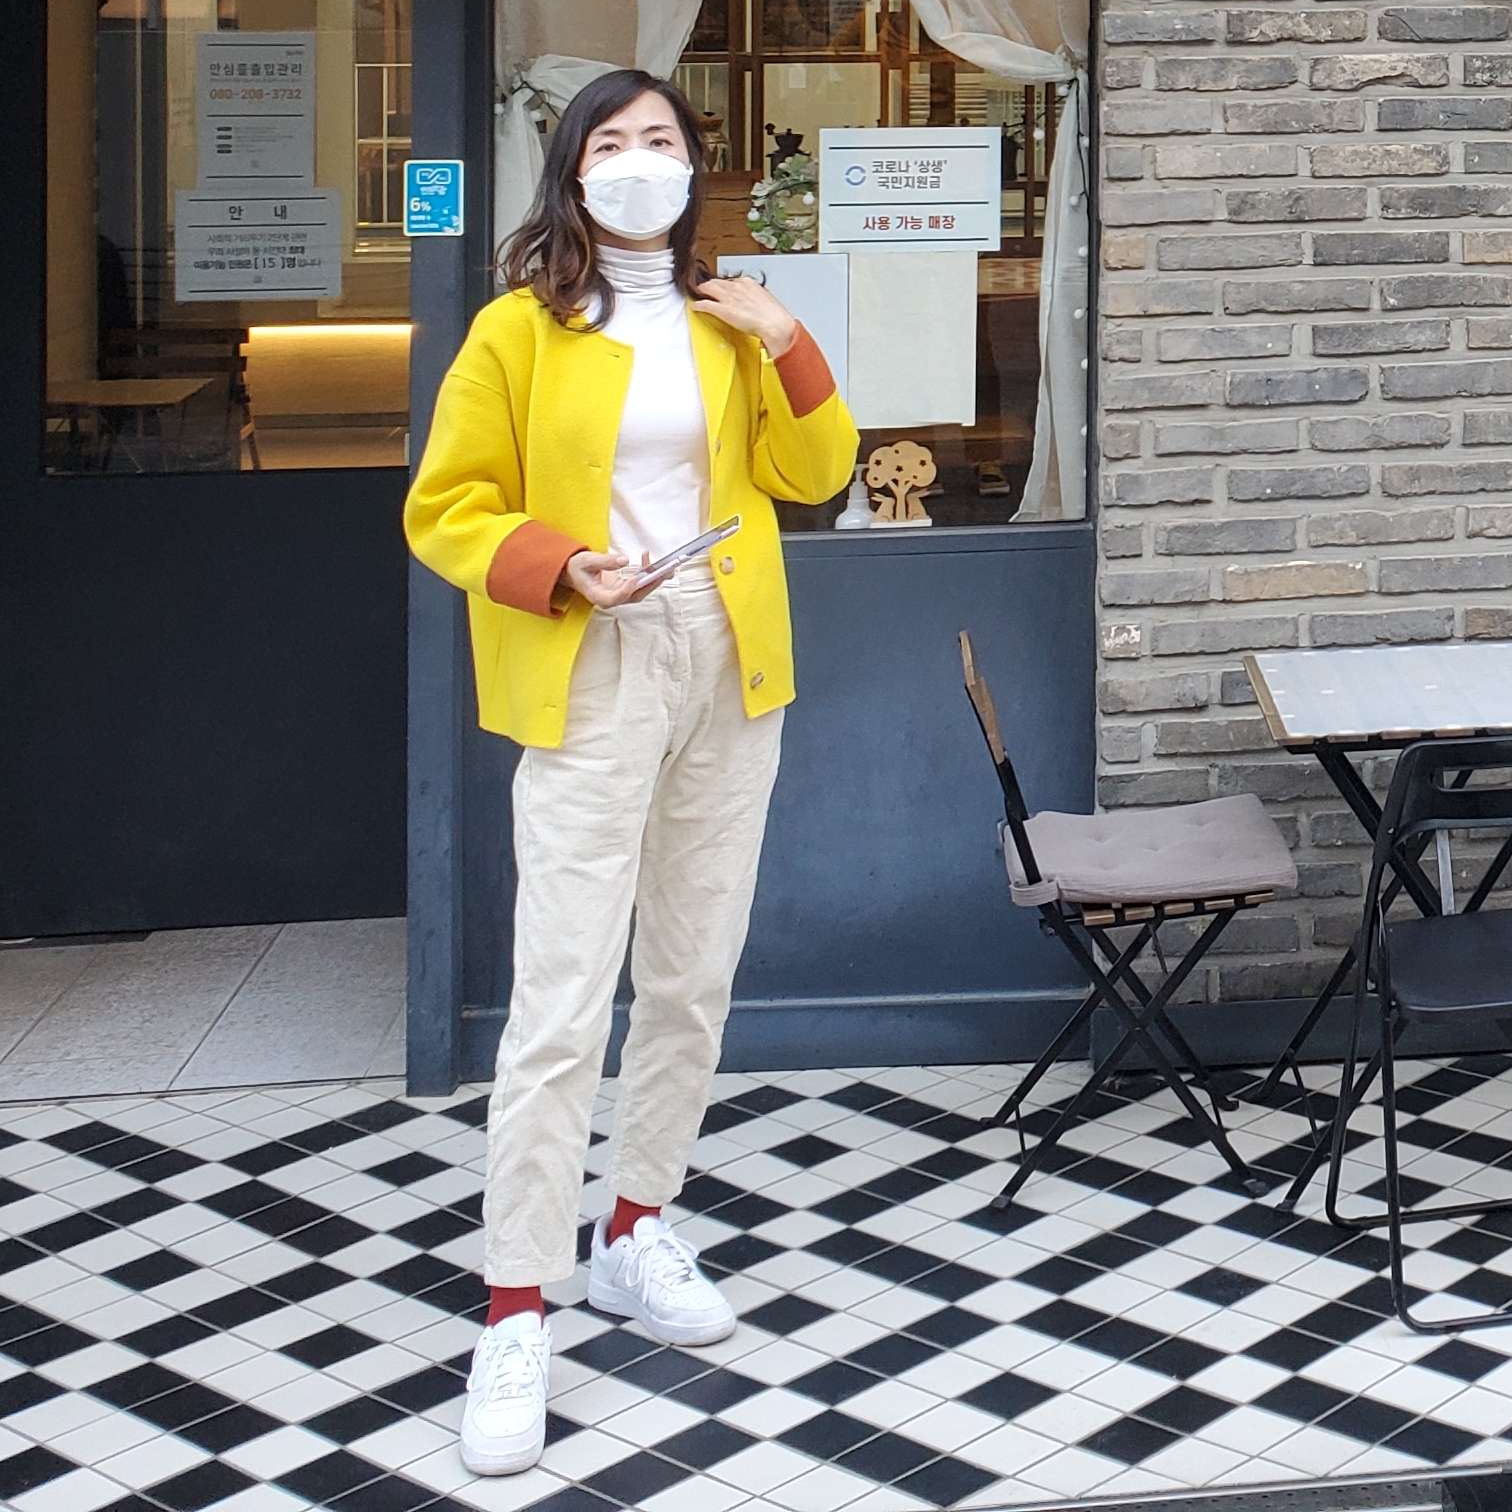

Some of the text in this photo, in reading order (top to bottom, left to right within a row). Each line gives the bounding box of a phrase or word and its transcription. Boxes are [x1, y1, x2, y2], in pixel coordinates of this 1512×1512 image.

[871, 160, 910, 174] 코로나
[877, 175, 942, 189] 국민지원금
[410, 197, 431, 212] 6%
[228, 204, 287, 221] 안 내
[863, 215, 956, 231] 사용 가능 매장
